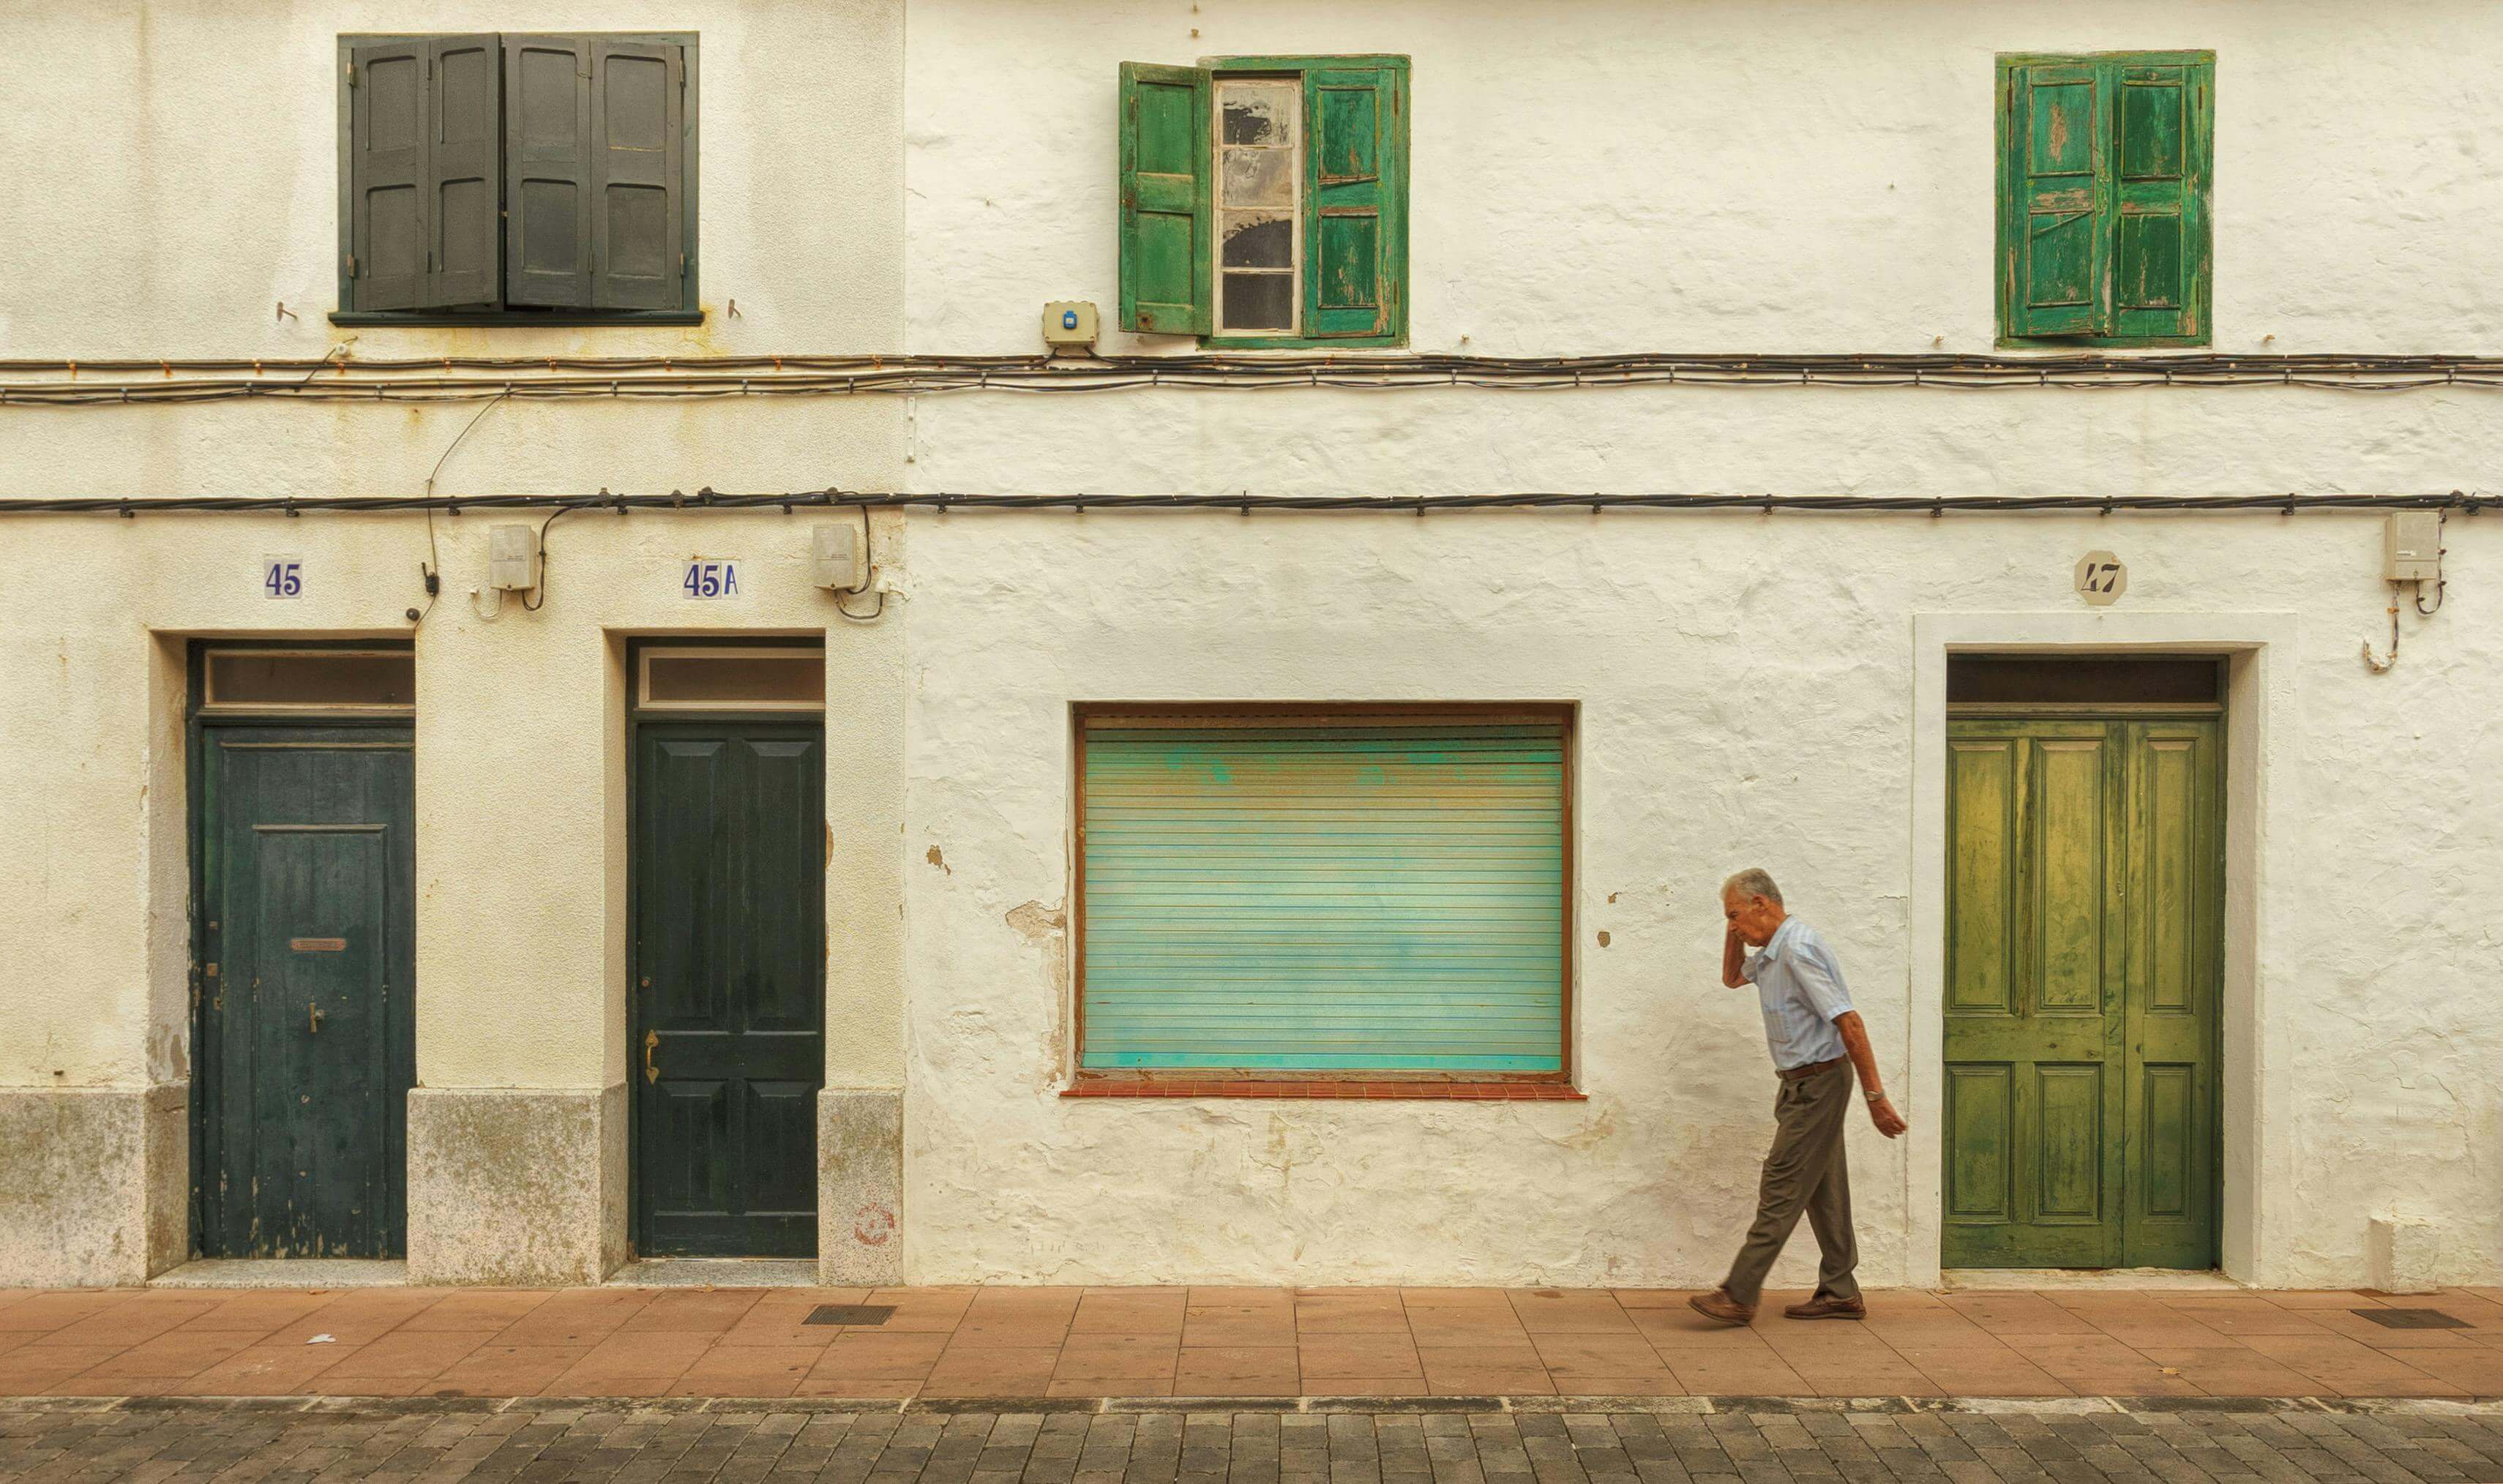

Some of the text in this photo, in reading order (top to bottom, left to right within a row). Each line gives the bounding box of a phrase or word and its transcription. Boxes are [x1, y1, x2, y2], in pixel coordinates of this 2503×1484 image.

[266, 563, 300, 596] 45
[684, 564, 738, 597] 45A
[2081, 563, 2120, 593] 47
